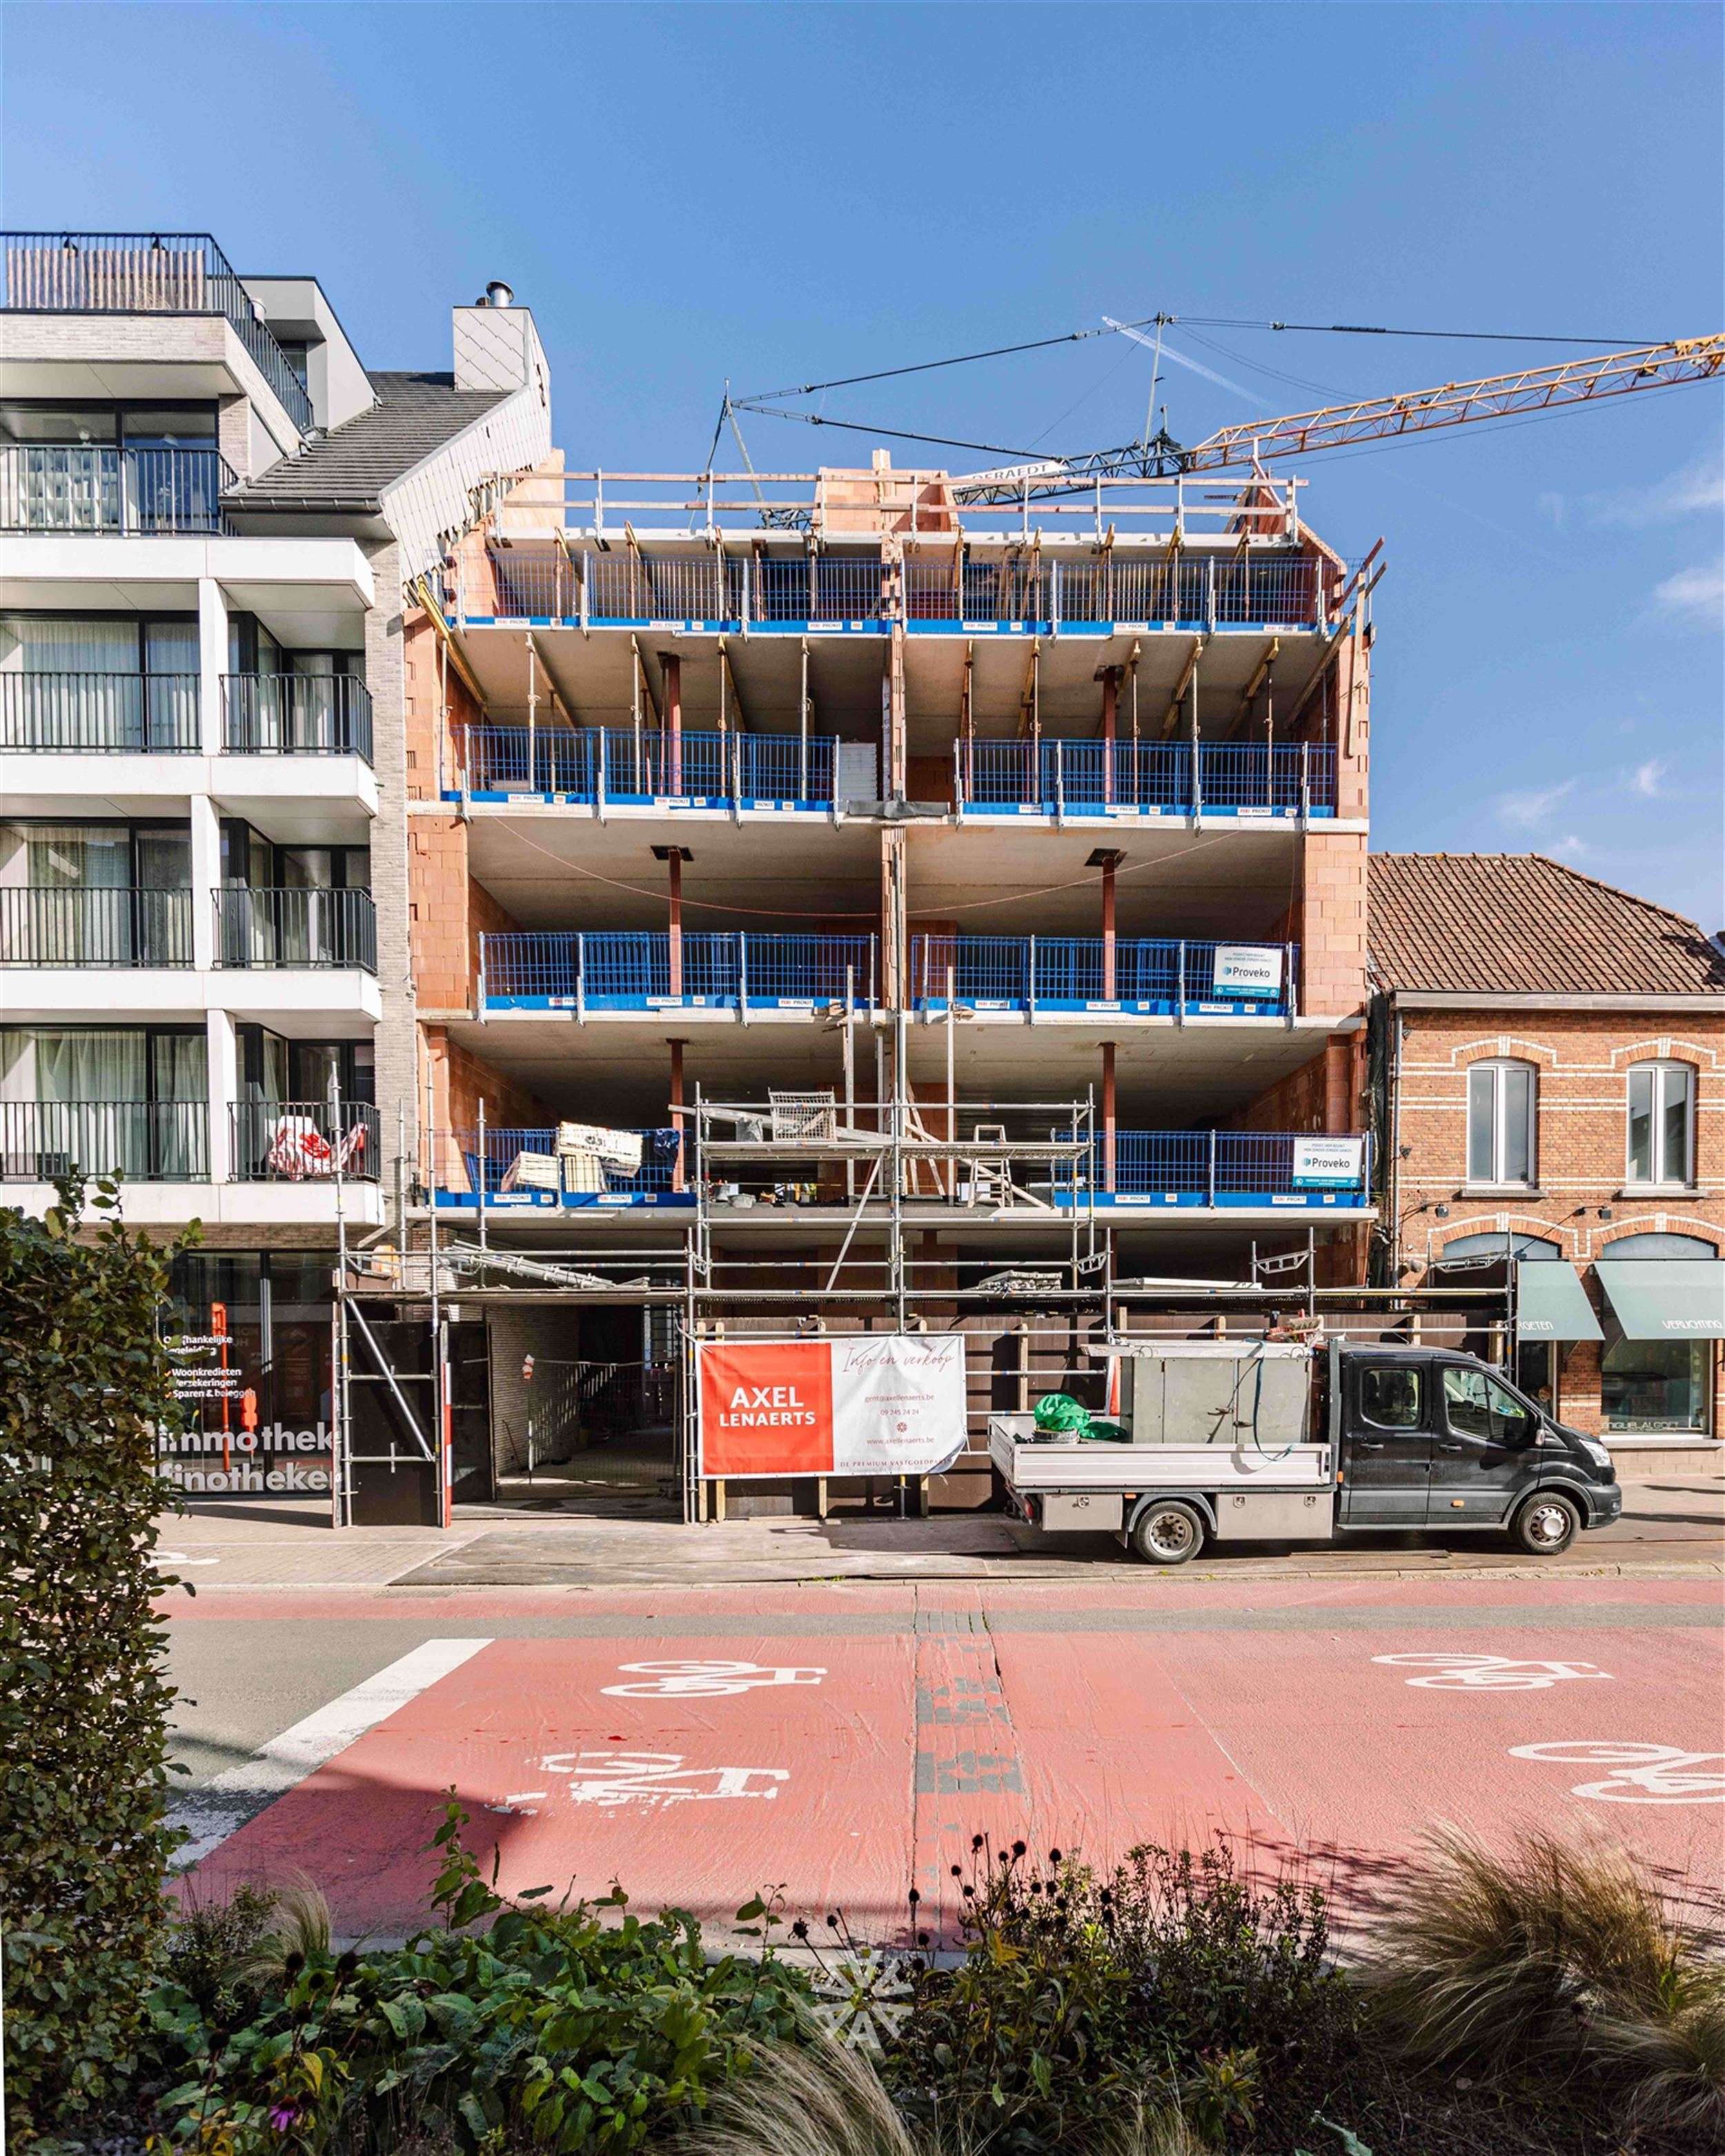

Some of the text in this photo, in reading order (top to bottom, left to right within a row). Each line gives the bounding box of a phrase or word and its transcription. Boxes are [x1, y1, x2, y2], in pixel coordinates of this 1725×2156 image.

[1232, 967, 1270, 978] Proveko
[1312, 1158, 1350, 1168] Proveko
[843, 1345, 955, 1375] Info en verkoop
[172, 1367, 242, 1376] Woonkredieten
[172, 1389, 205, 1399] Sparen
[731, 1387, 804, 1409] AXEL
[720, 1412, 816, 1427] LENAERTS
